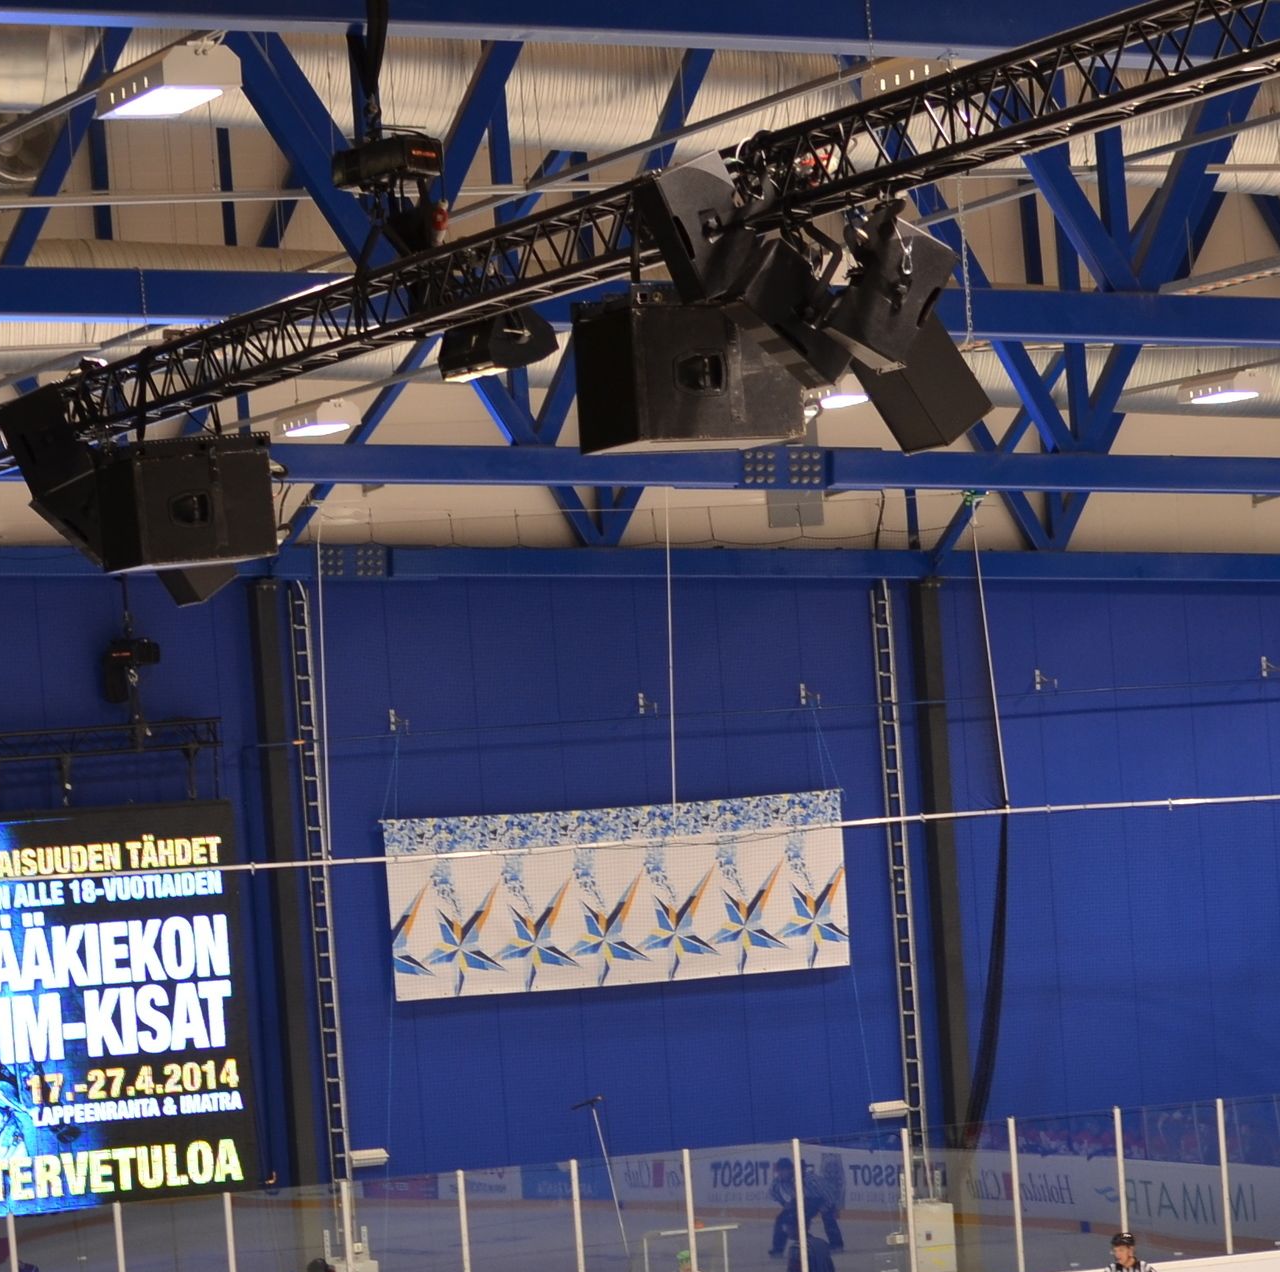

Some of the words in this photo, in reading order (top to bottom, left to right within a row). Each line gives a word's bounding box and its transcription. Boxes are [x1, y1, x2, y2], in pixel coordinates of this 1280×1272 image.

[125, 834, 222, 869] TÄHDET
[14, 880, 65, 909] ALLE
[69, 870, 223, 904] 18-VUOTIAIDEN
[27, 1058, 239, 1105] 17.-27.4.2014
[32, 1097, 160, 1127] LAPPEENRANTA
[163, 1096, 177, 1116] &
[180, 1090, 244, 1114] IMATRA
